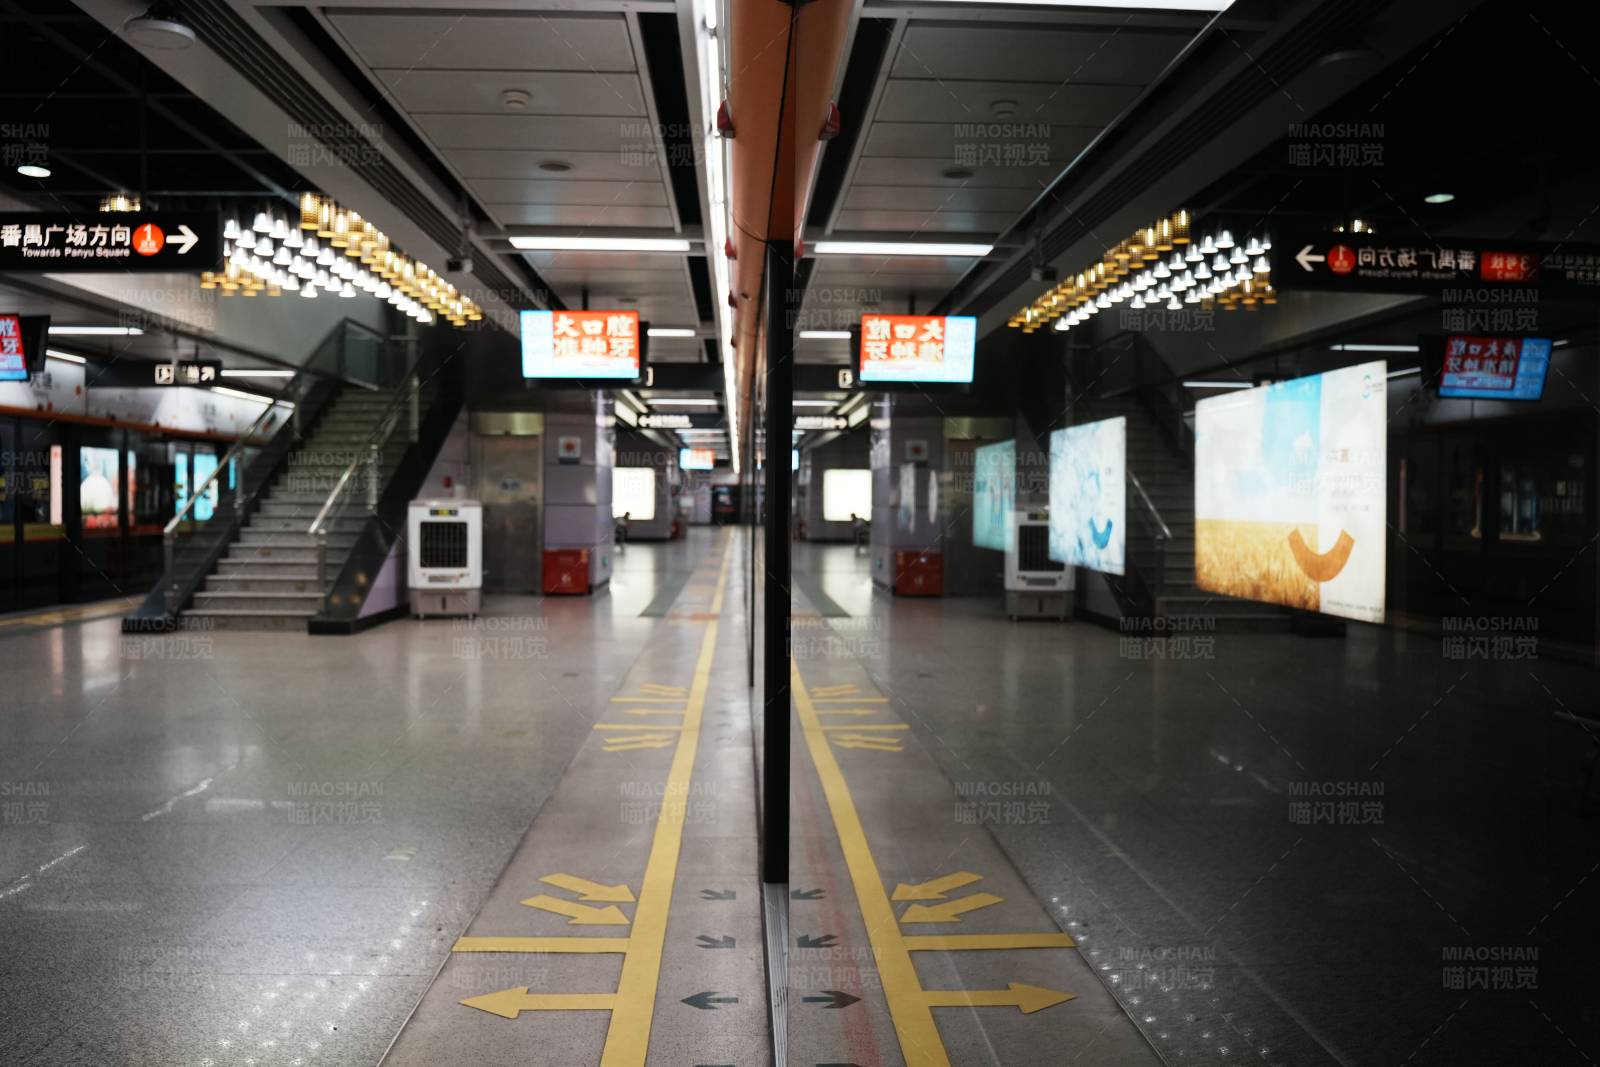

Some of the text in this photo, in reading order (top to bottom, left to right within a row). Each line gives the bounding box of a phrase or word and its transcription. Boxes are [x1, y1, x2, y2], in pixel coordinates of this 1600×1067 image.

[1, 224, 130, 247] 番禺广场方向
[143, 224, 153, 241] 1
[22, 247, 130, 258] Towards Panyu Square
[554, 313, 634, 337] 大口腔
